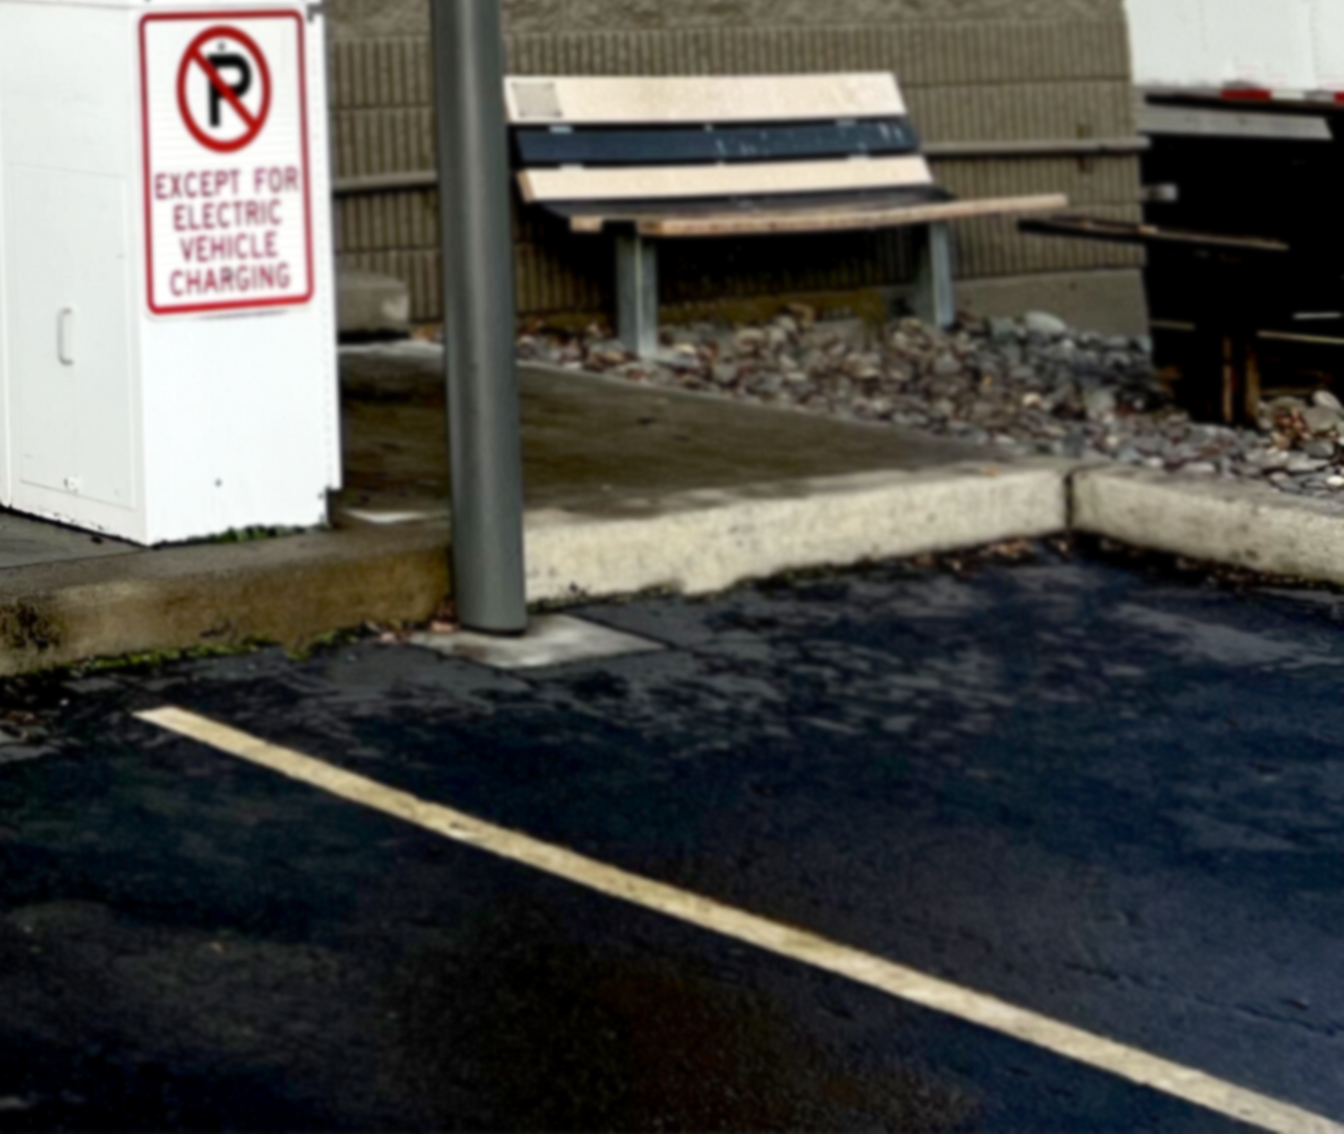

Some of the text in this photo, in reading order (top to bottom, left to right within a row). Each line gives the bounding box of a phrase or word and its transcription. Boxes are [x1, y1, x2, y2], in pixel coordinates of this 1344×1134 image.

[154, 166, 298, 200] EXCEPT FOR
[173, 200, 282, 231] ELECTRIC
[179, 232, 278, 262] VEHICLE
[169, 264, 291, 296] CHARGING
